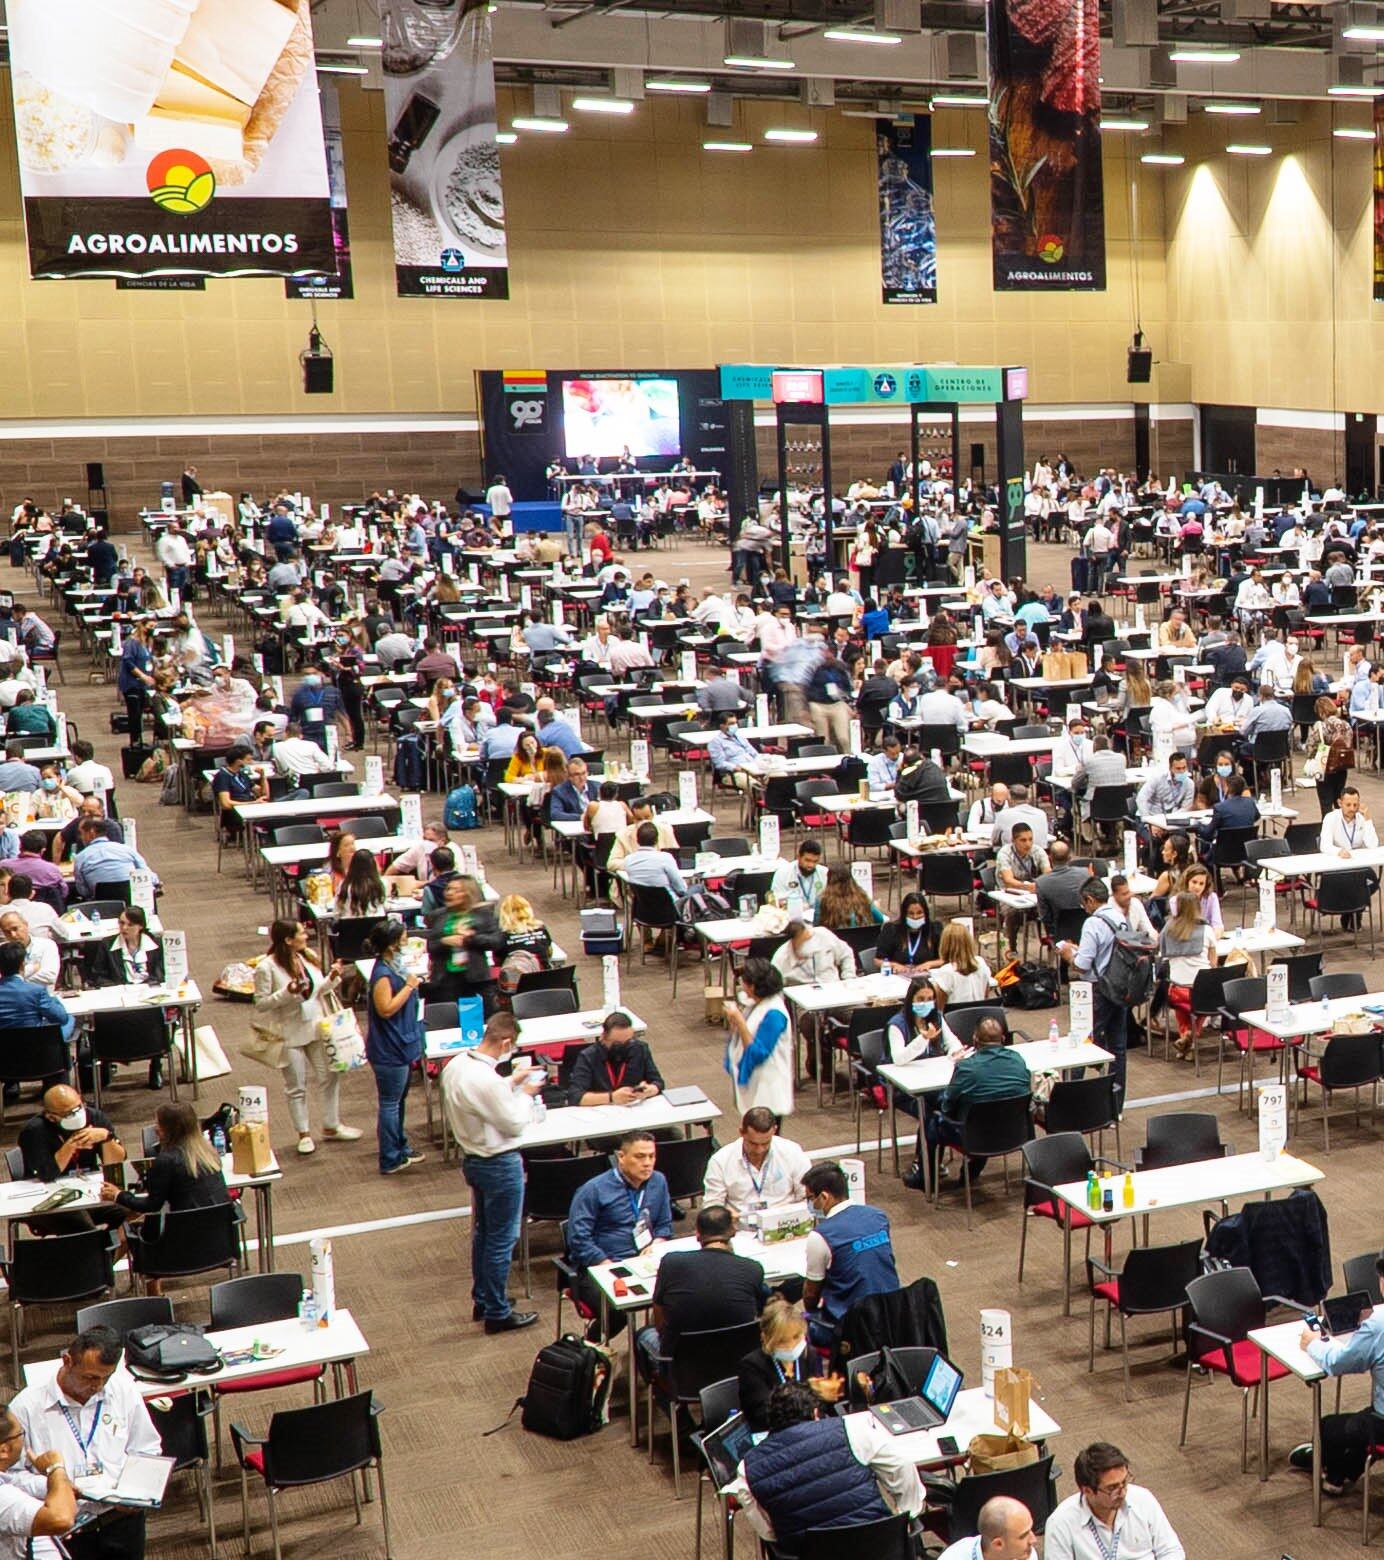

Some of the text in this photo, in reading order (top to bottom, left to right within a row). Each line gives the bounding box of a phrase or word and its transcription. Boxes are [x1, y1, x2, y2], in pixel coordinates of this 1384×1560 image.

[68, 233, 299, 254] AGROALIMENTOS
[419, 276, 488, 285] CHEMICALS AND
[1007, 271, 1093, 281] AGROALIMENTOS
[126, 279, 156, 287] CIENCIAS
[180, 280, 197, 288] VIDA
[425, 285, 483, 293] LIFE SCIENCES
[240, 1096, 261, 1106] 794
[1263, 1096, 1282, 1106] 797
